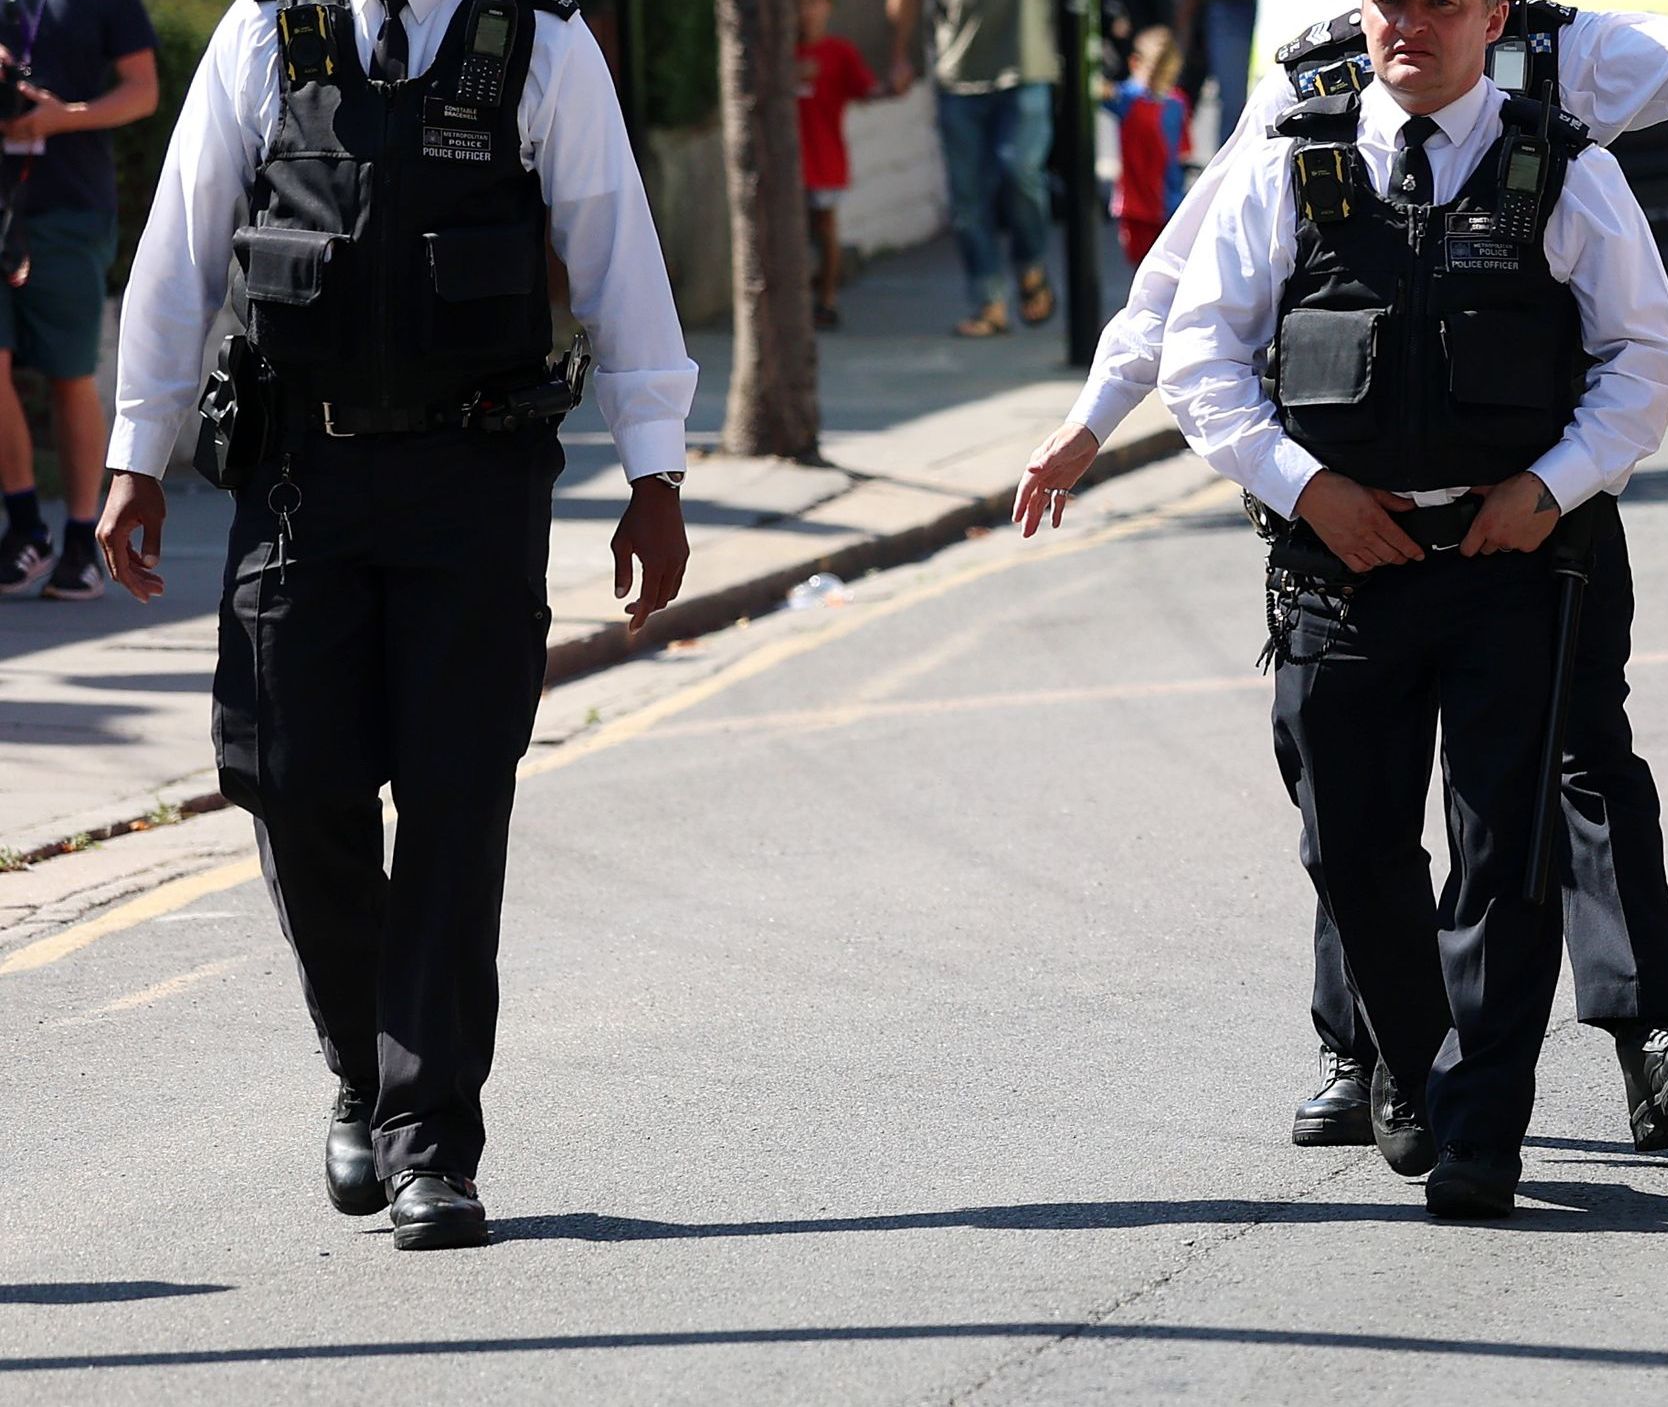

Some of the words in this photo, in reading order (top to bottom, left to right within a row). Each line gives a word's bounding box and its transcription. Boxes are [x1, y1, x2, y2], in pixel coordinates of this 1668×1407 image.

[443, 132, 489, 140] METROPOLITAN
[448, 139, 482, 148] POLICE
[423, 147, 453, 158] POLICE
[455, 150, 491, 161] OFFICER
[1479, 248, 1508, 256] POLICE
[1451, 260, 1482, 269] POLICE
[1483, 261, 1519, 270] OFFICER
